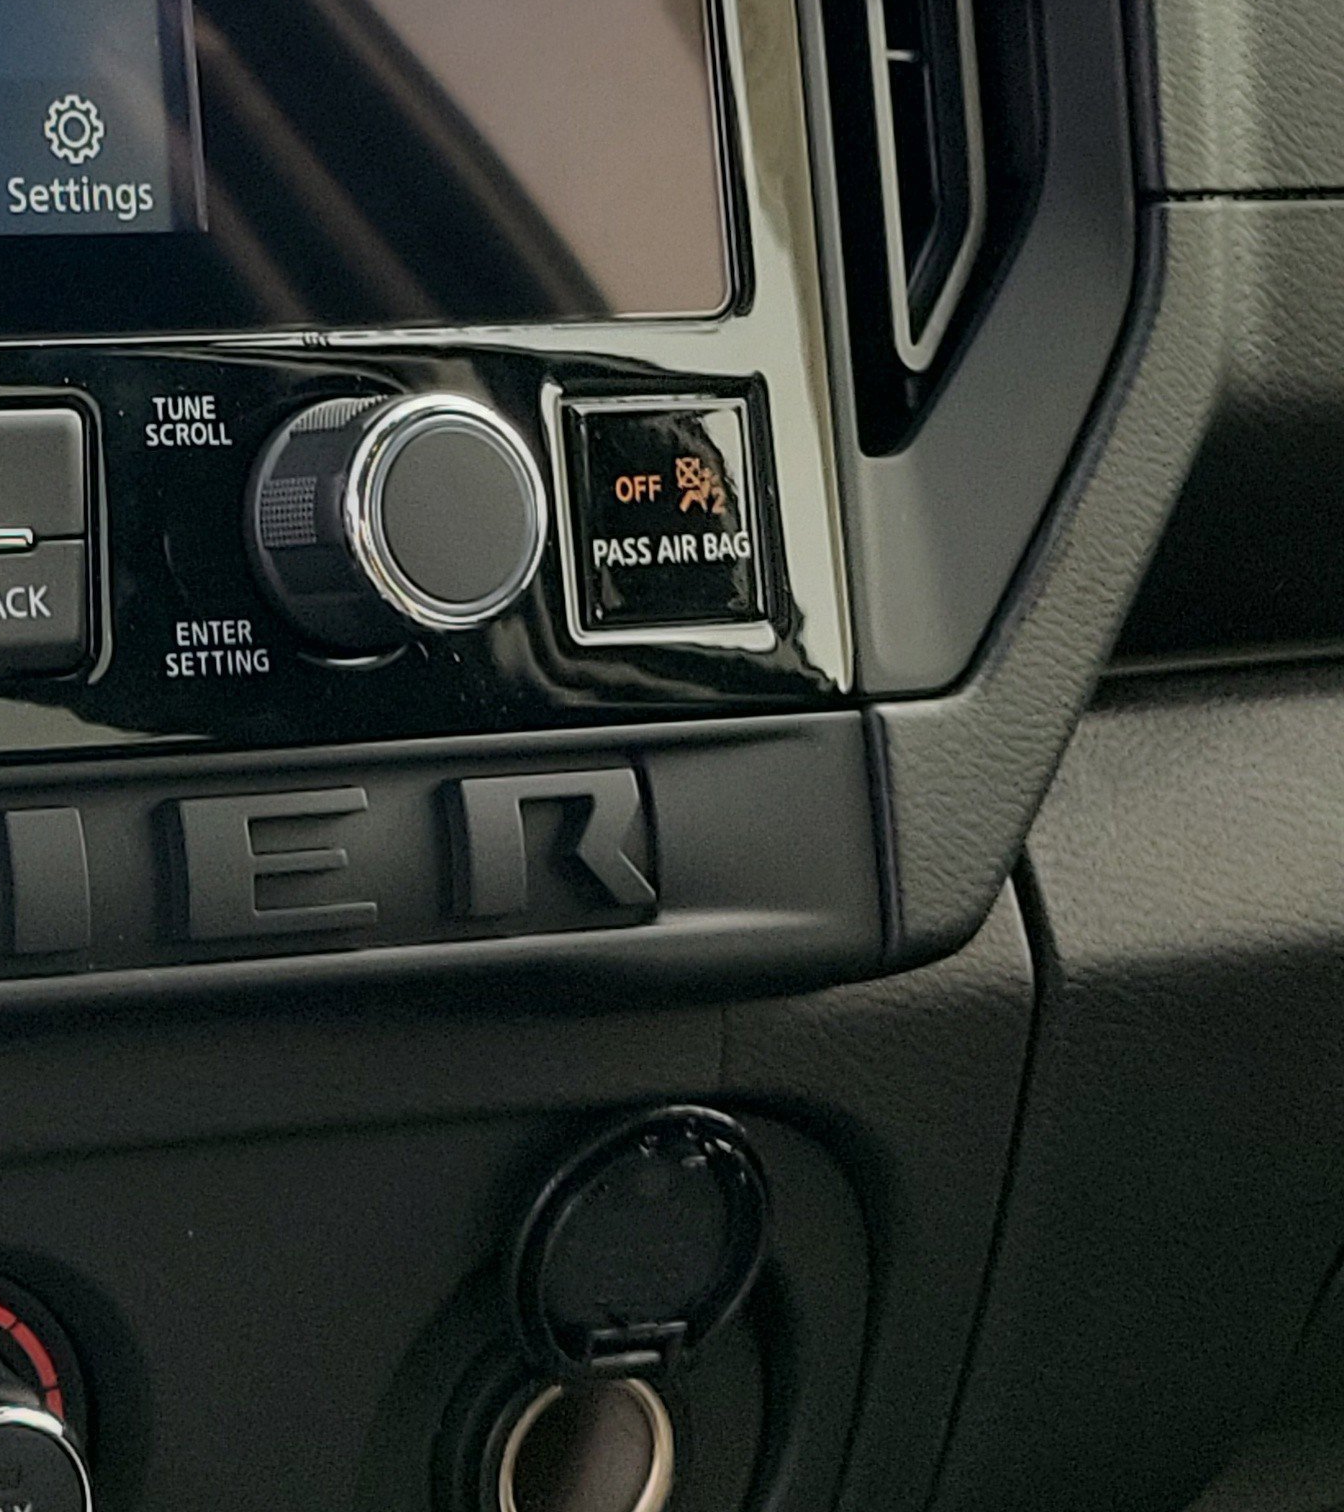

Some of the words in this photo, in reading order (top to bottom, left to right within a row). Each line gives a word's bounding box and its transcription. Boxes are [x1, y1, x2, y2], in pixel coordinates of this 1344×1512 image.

[7, 175, 153, 220] Settings
[152, 395, 216, 421] TUNE
[145, 421, 233, 447] SCROLL
[615, 474, 662, 503] OFF
[592, 536, 652, 568] PASS
[657, 533, 698, 564] AIR
[702, 530, 751, 562] BAG
[176, 619, 253, 647] ENTER
[165, 649, 270, 678] SETTING
